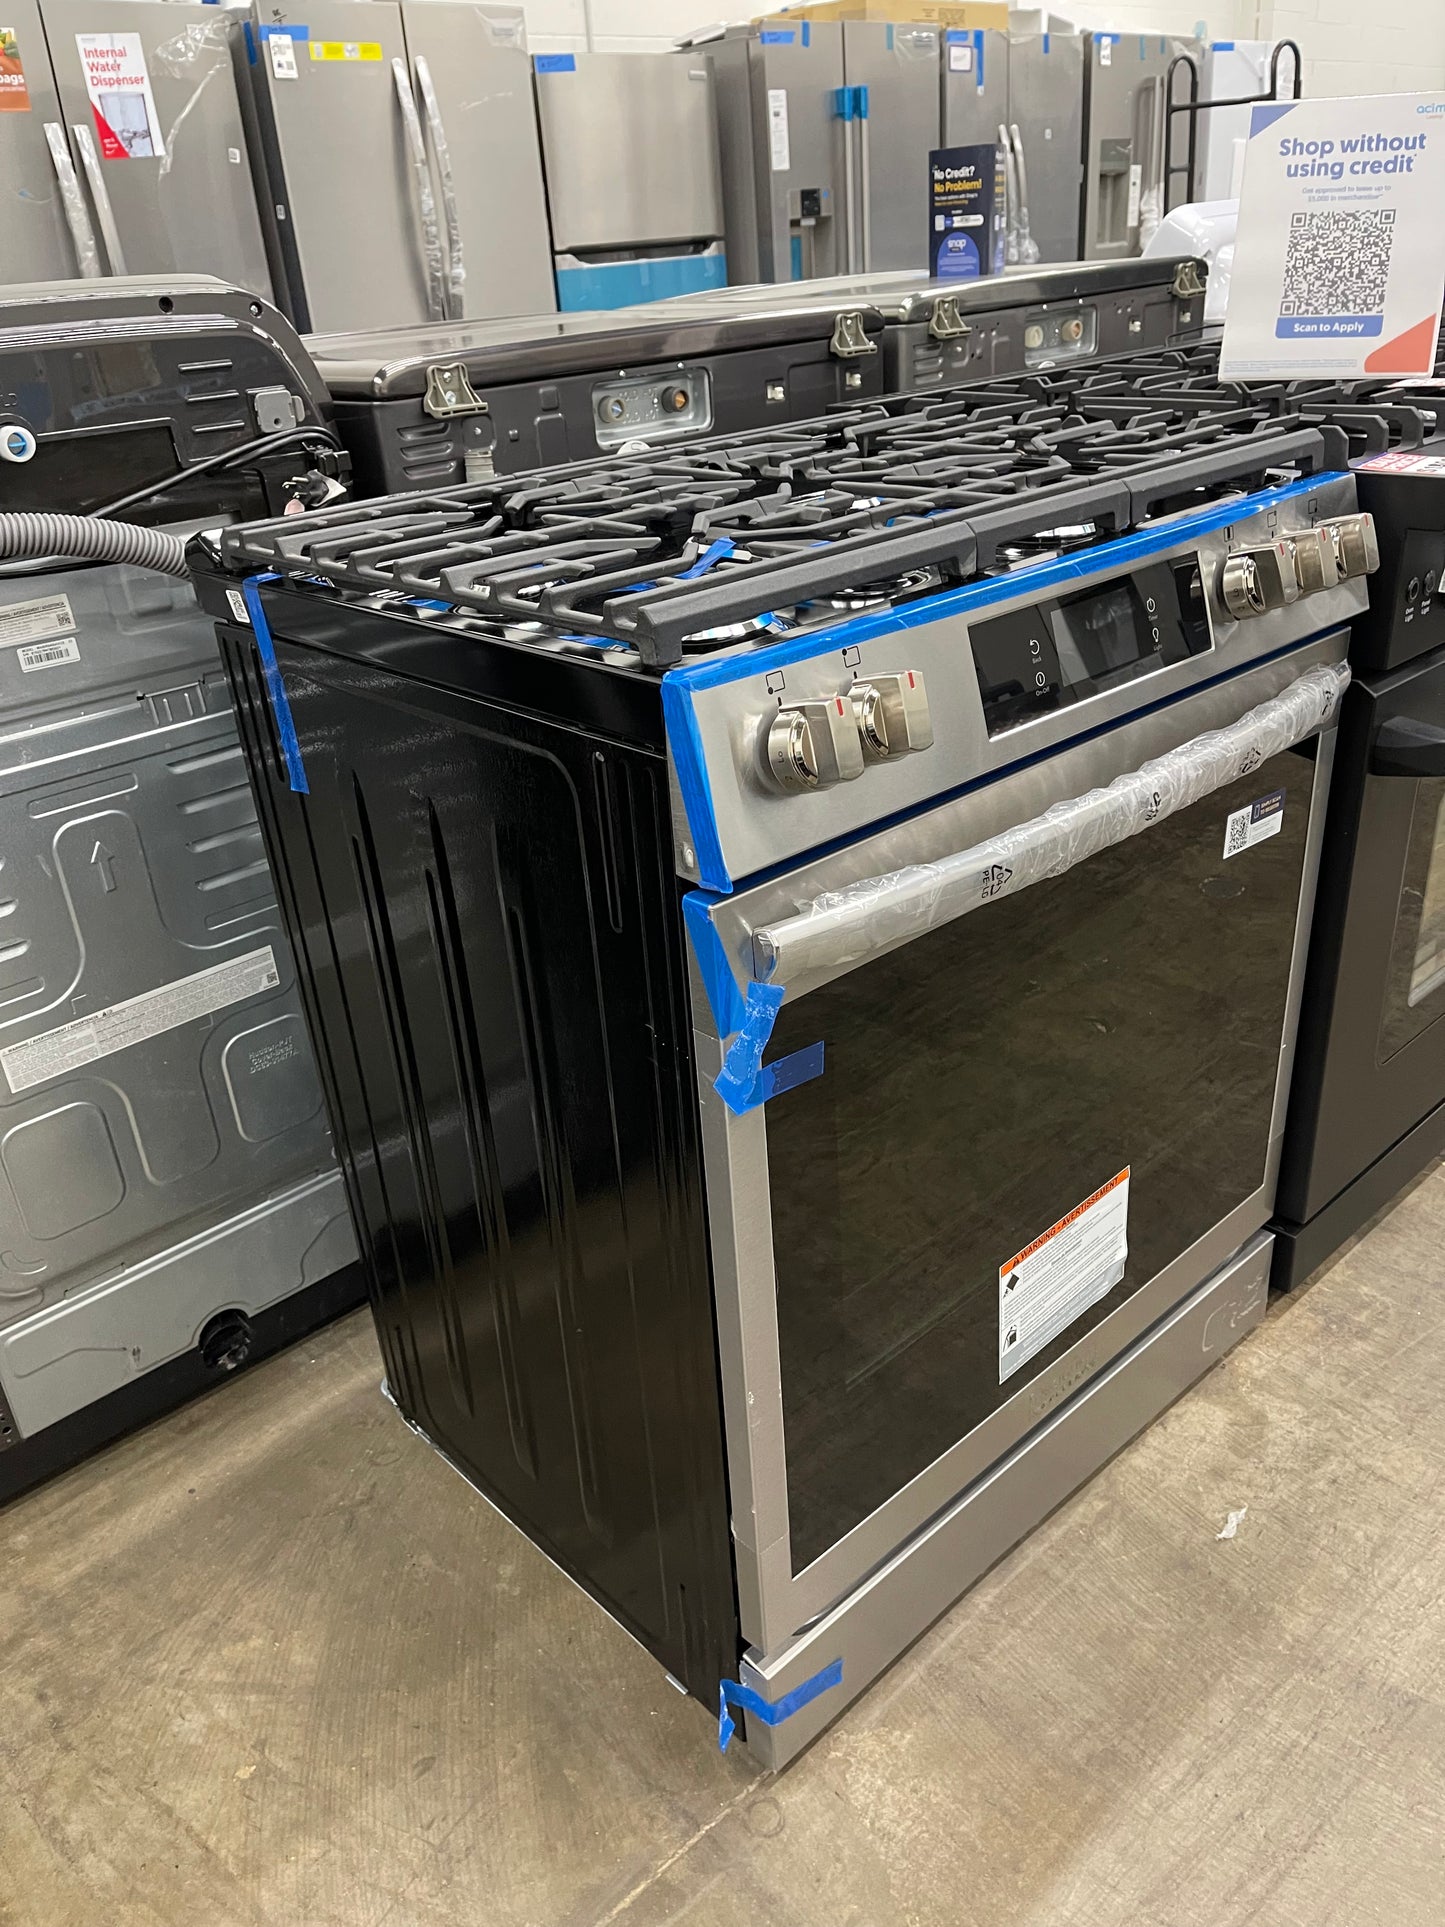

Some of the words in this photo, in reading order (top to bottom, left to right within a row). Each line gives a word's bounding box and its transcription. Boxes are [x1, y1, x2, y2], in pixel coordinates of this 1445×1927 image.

[84, 46, 127, 58] Internal
[86, 61, 121, 72] Water
[90, 75, 145, 87] Dispenser
[1279, 138, 1335, 158] Shop
[1340, 133, 1427, 154] without
[934, 169, 945, 180] No
[945, 165, 976, 179] Credit?
[1286, 159, 1344, 180] using
[934, 182, 945, 193] No
[945, 178, 982, 192] Problem!
[1293, 322, 1318, 333] Scan
[1319, 323, 1331, 332] to
[1332, 321, 1364, 333] Apply
[1020, 1227, 1056, 1260] WARNING
[1061, 1176, 1119, 1229] AVERTISSEMENT
